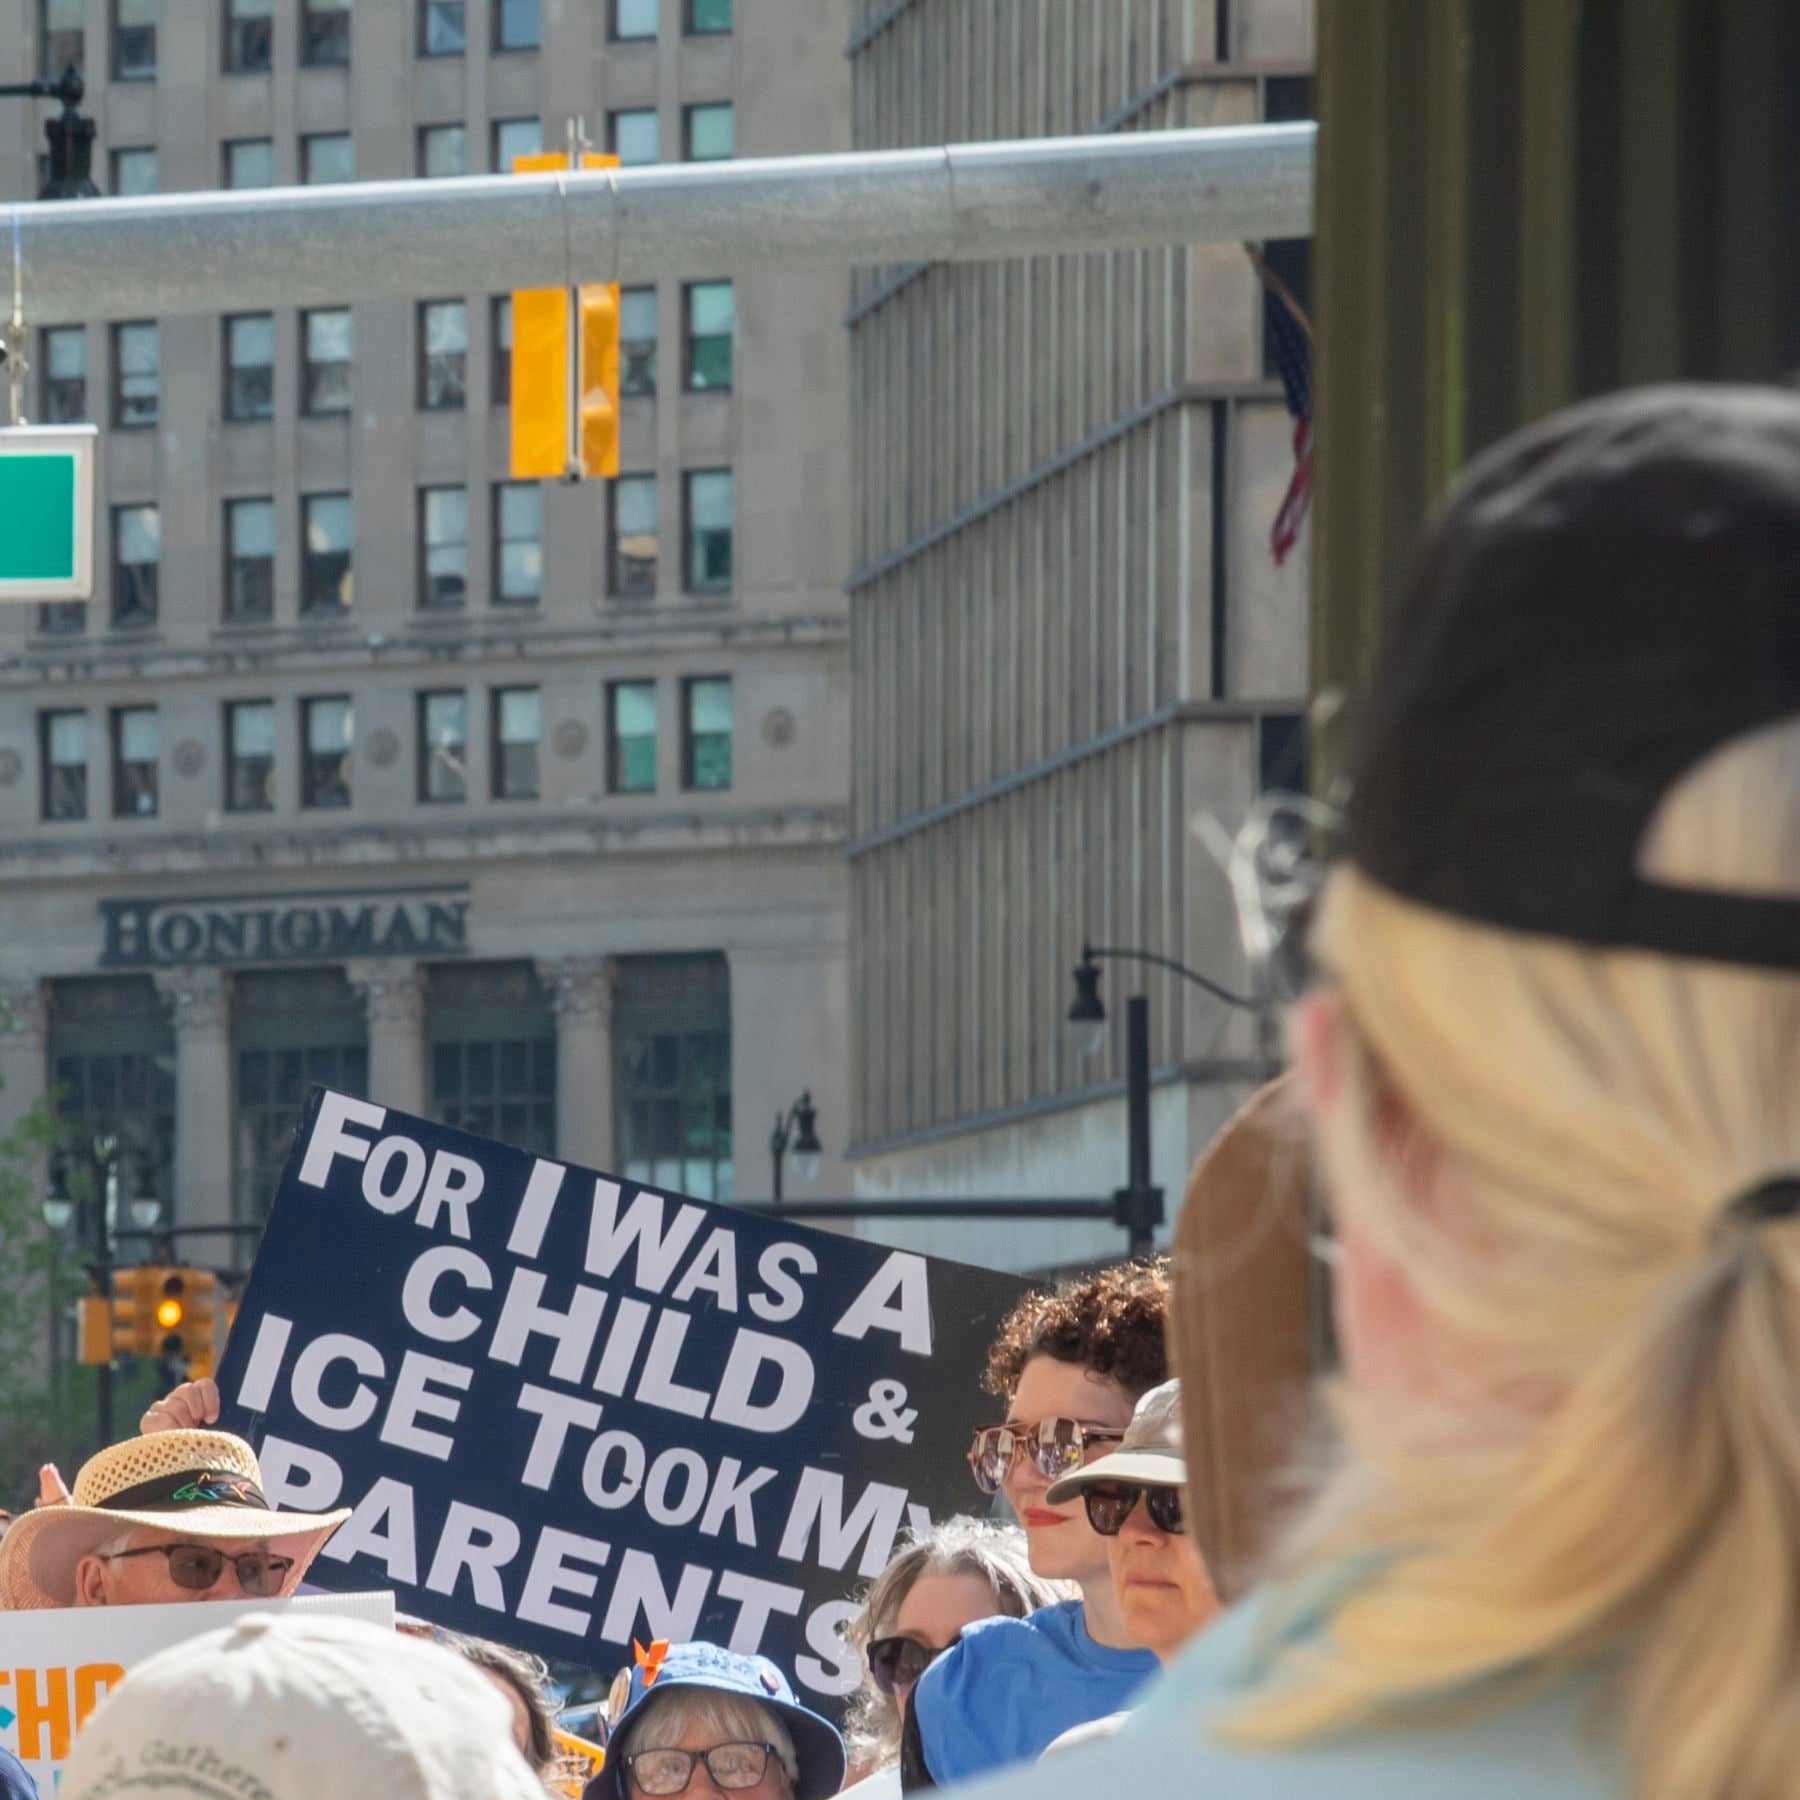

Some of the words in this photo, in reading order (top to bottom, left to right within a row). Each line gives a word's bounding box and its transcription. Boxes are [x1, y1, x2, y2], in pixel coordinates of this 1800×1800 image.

[103, 901, 469, 959] HONIGMAN
[298, 1090, 486, 1240] FOR
[506, 1158, 566, 1260] I
[583, 1178, 818, 1323] WAS
[832, 1250, 932, 1358] A
[236, 1312, 474, 1463] ICE
[517, 1382, 779, 1547] TOOK
[401, 1245, 816, 1434] CHILD
[852, 1378, 919, 1445] &
[257, 1434, 864, 1697] PARENTS
